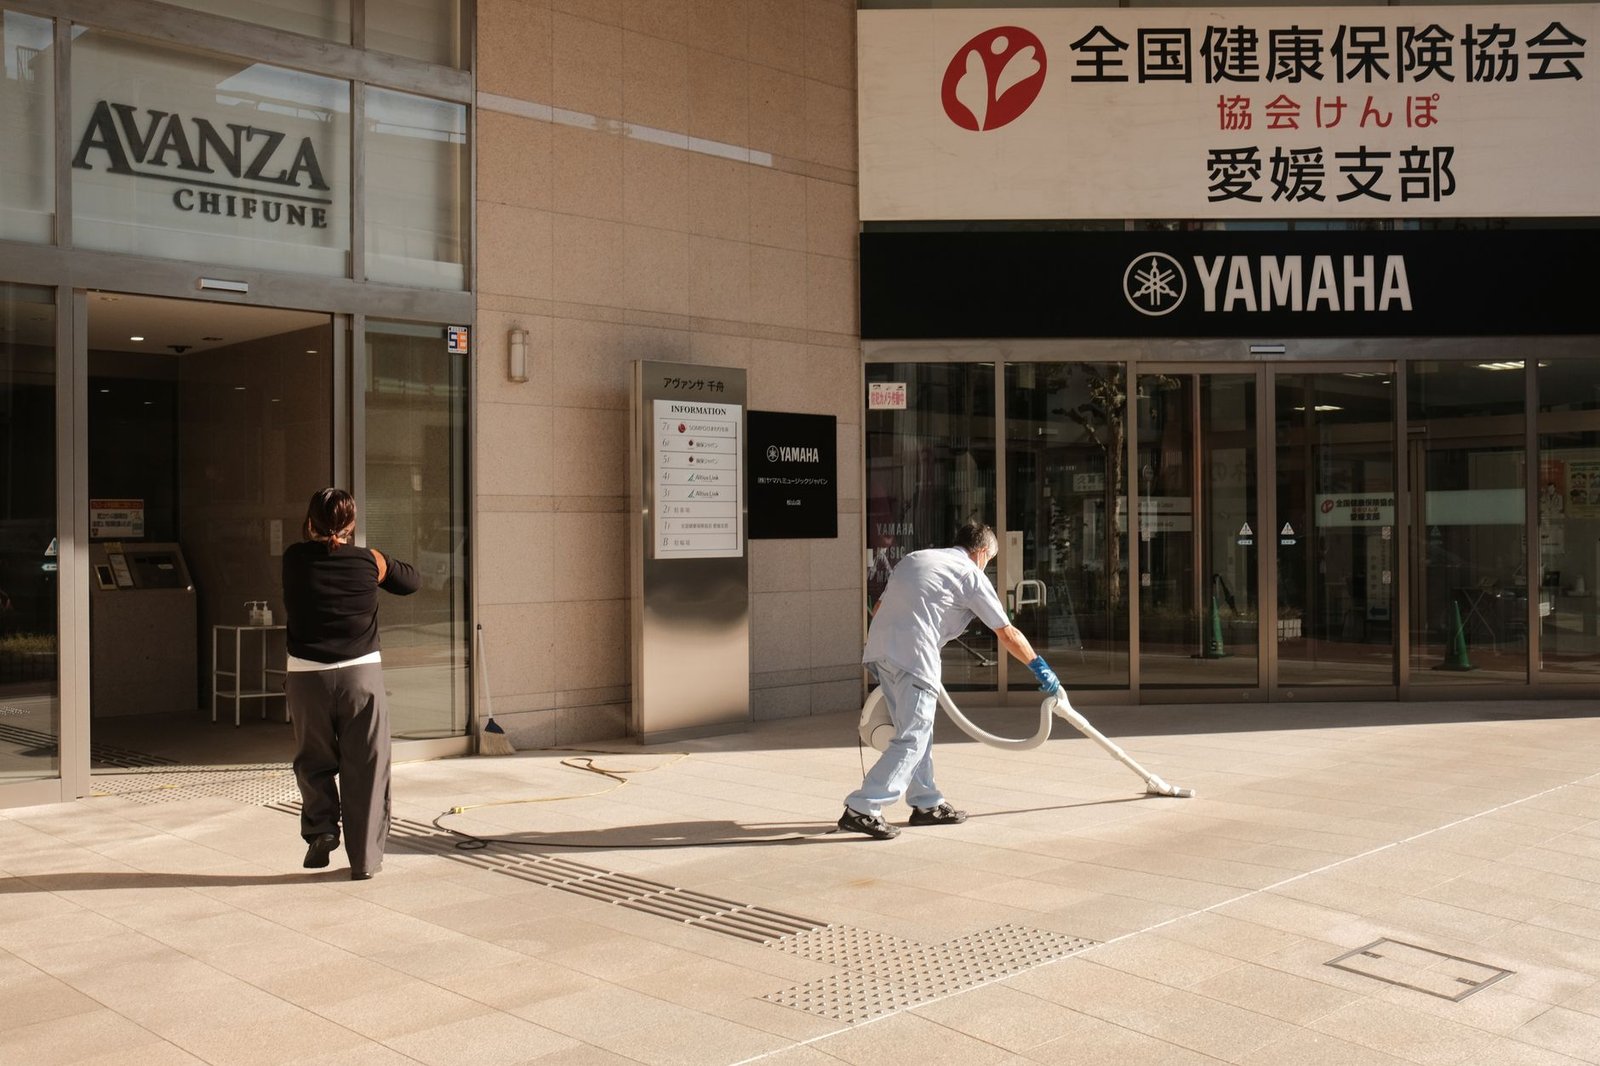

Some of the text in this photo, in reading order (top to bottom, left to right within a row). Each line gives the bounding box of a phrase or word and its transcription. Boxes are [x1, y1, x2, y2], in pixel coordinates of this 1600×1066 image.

[1068, 21, 1587, 84] 全国健康保険協会
[1216, 93, 1441, 131] 協会けんぽ
[72, 99, 331, 192] AVANZA
[1205, 144, 1457, 204] 愛媛支部
[172, 188, 329, 230] CHIFUNE
[1193, 253, 1413, 313] YAMAHA
[671, 405, 727, 416] INFORMATION
[779, 446, 820, 464] YAMAHA
[876, 522, 915, 536] YAMAHA
